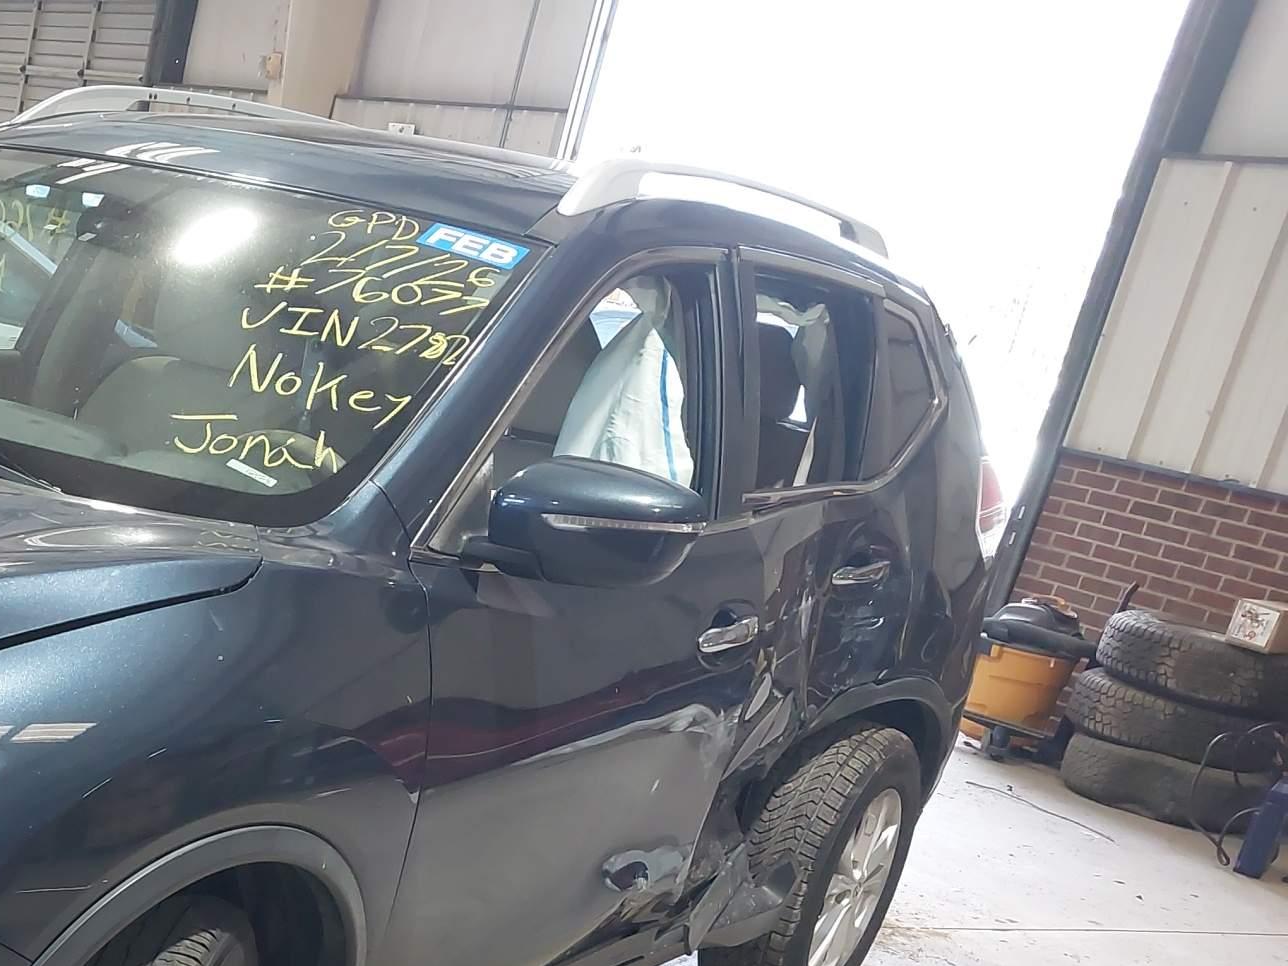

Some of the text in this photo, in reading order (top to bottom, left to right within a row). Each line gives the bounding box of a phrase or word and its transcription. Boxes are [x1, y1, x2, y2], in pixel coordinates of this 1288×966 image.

[327, 209, 421, 242] GPD
[300, 230, 501, 289] 2/7/26
[425, 226, 518, 265] FEB
